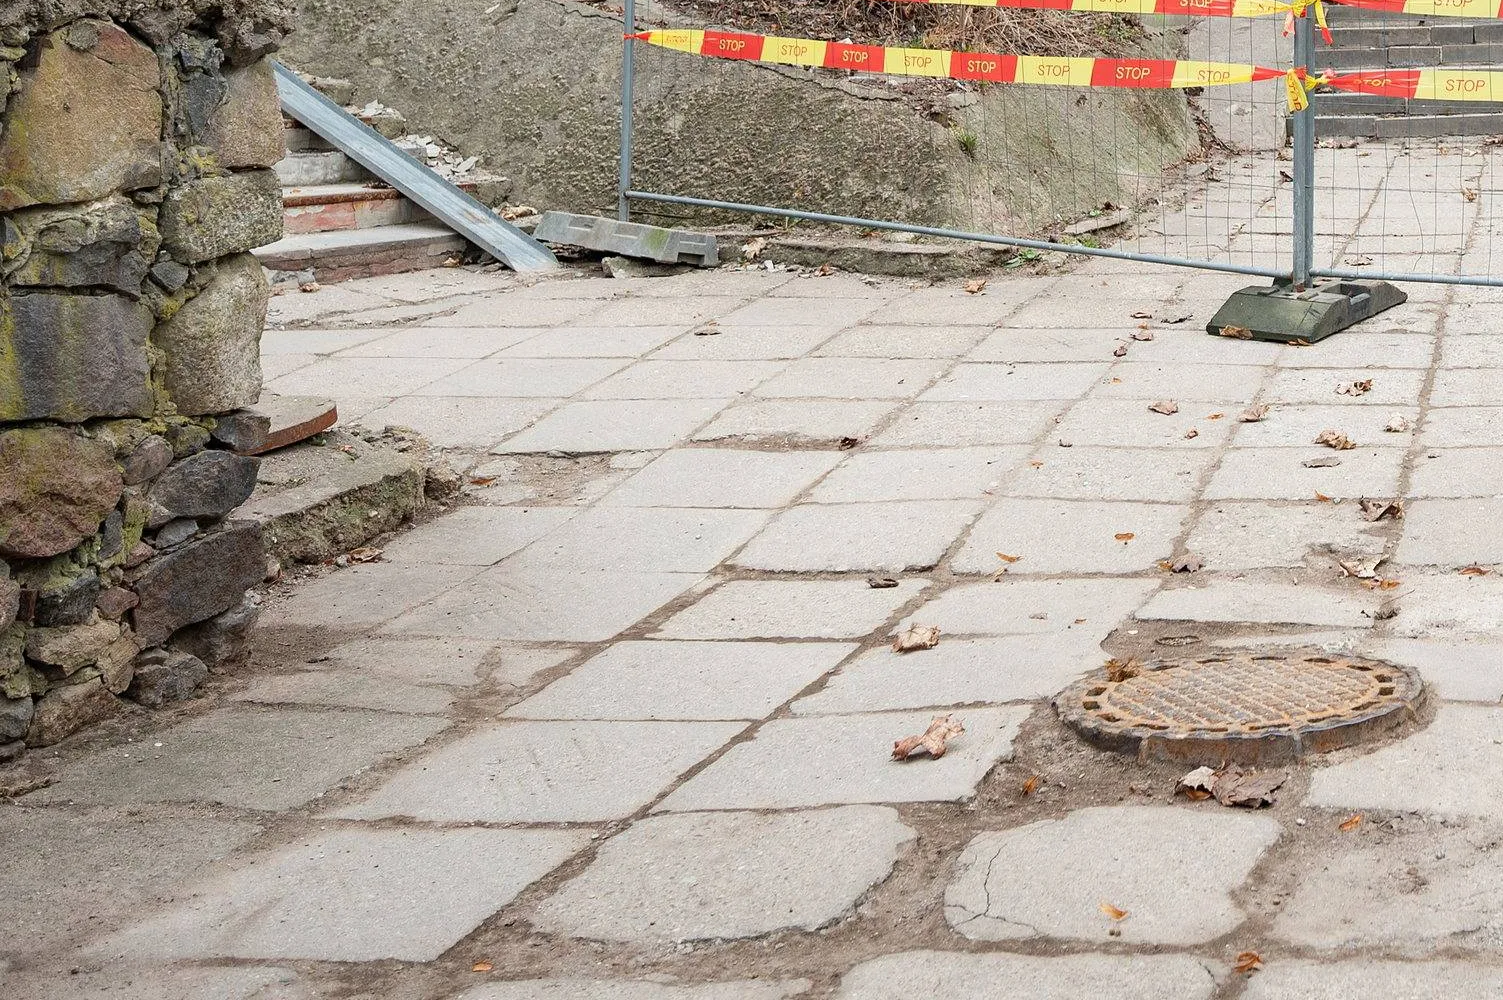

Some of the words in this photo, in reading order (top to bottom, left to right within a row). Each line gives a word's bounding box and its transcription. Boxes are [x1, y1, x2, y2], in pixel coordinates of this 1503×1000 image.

[719, 39, 746, 51] STOP
[781, 45, 808, 57] STOP
[843, 50, 868, 63] STOP
[904, 56, 932, 68] STOP
[967, 61, 997, 72] STOP
[1037, 65, 1070, 77] STOP
[1115, 67, 1150, 80] STOP
[1198, 70, 1231, 82] STOP
[1445, 79, 1485, 92] STOP
